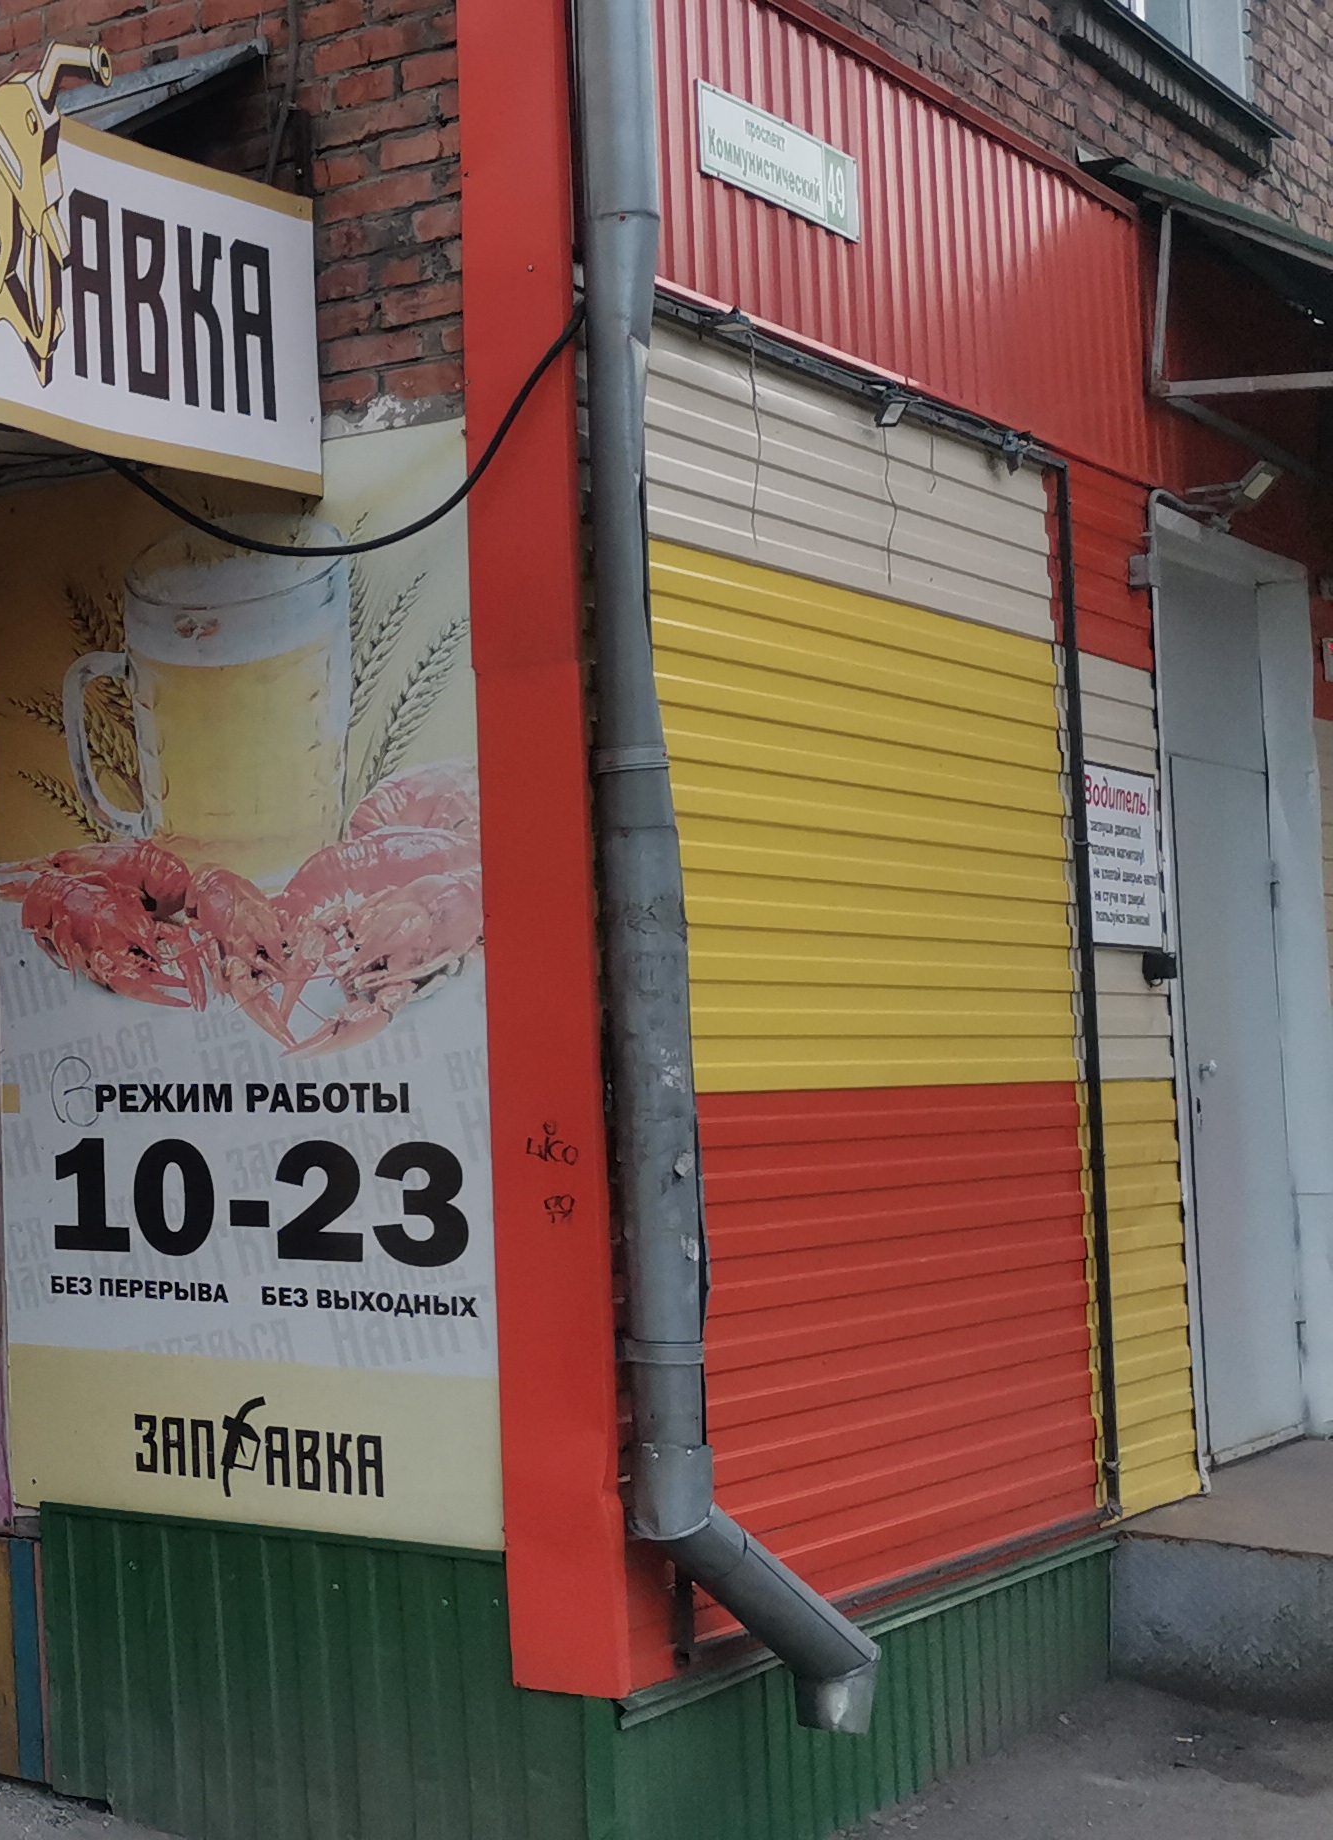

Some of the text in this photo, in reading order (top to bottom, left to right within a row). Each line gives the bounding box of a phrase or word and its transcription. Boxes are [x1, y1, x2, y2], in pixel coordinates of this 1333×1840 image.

[744, 118, 786, 152] проспект
[707, 125, 822, 206] Коммунистический
[827, 163, 846, 219] 49
[1084, 774, 1152, 817] Водитель!
[95, 1083, 410, 1114] РЕЖИМ РАБОТЫ
[54, 1137, 470, 1268] 10-23
[50, 1275, 229, 1304] БЕЗ ПЕРЕРЫВА
[261, 1286, 479, 1319] БЕЗ ВЫХОДНЫХ
